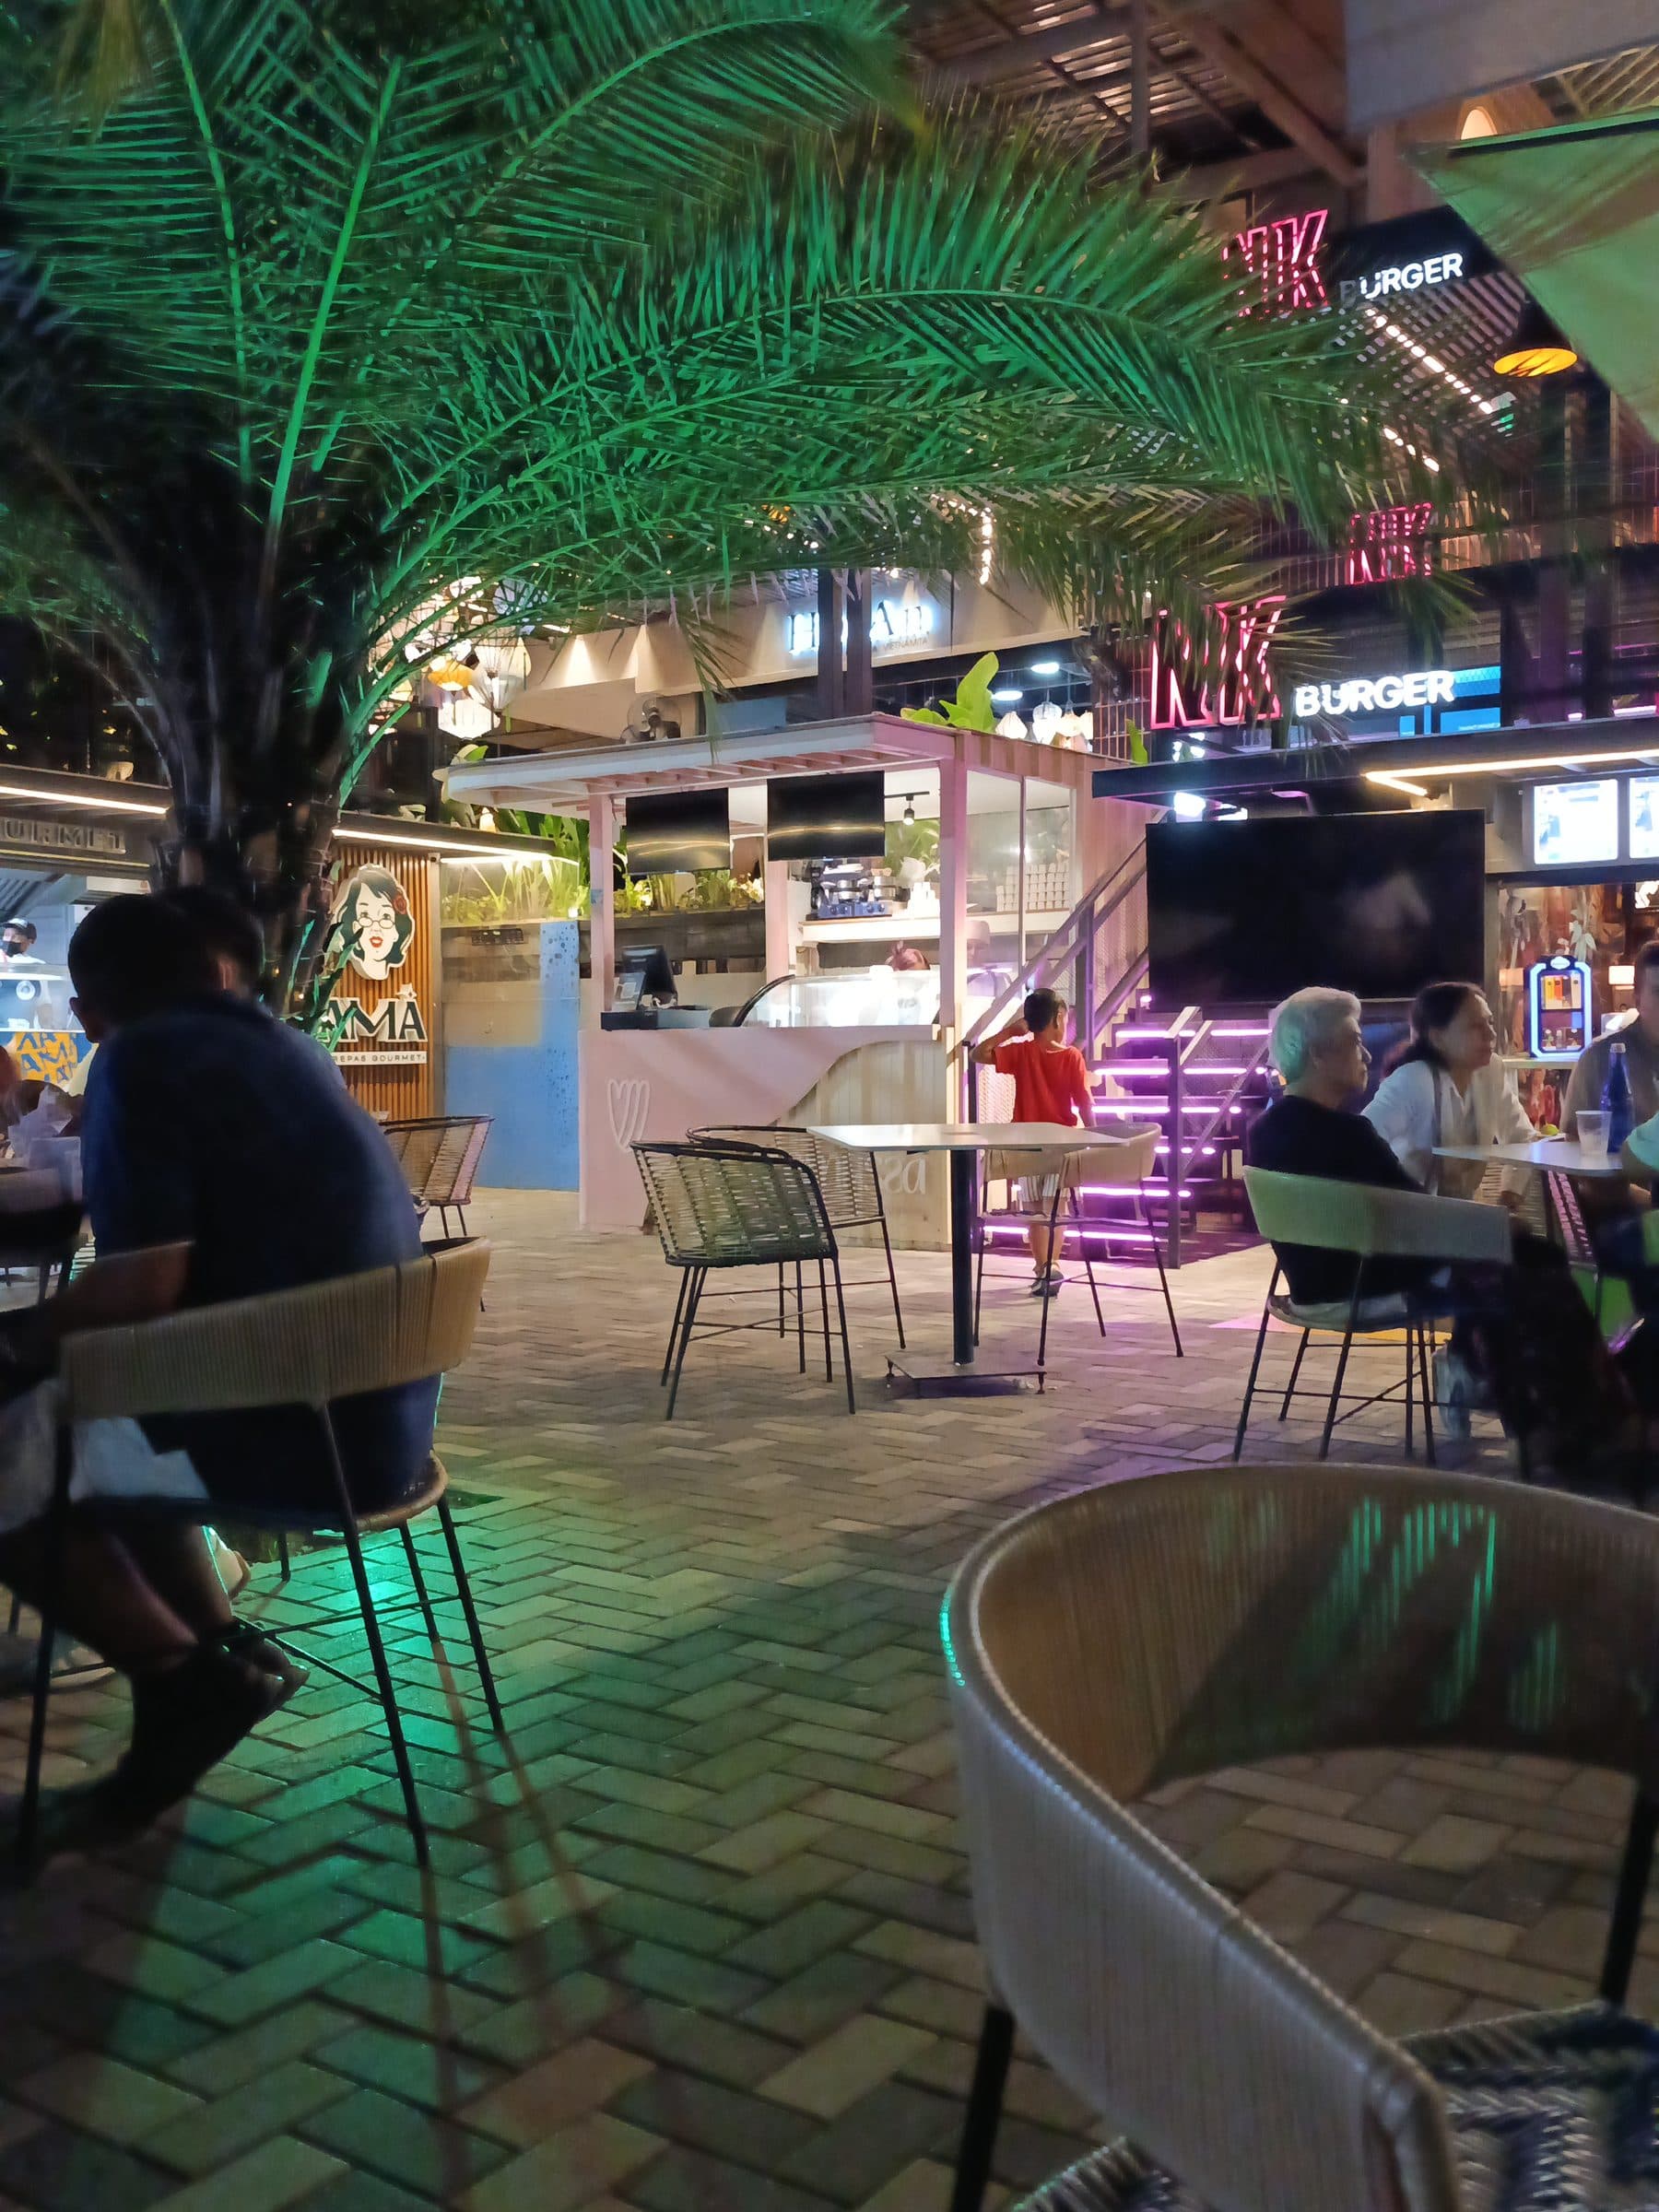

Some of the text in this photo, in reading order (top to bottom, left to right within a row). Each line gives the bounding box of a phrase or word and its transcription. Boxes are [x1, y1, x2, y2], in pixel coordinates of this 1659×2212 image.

[1339, 251, 1464, 308] BURGER
[1295, 669, 1455, 718] BURGER
[371, 1053, 422, 1063] GOURMET
